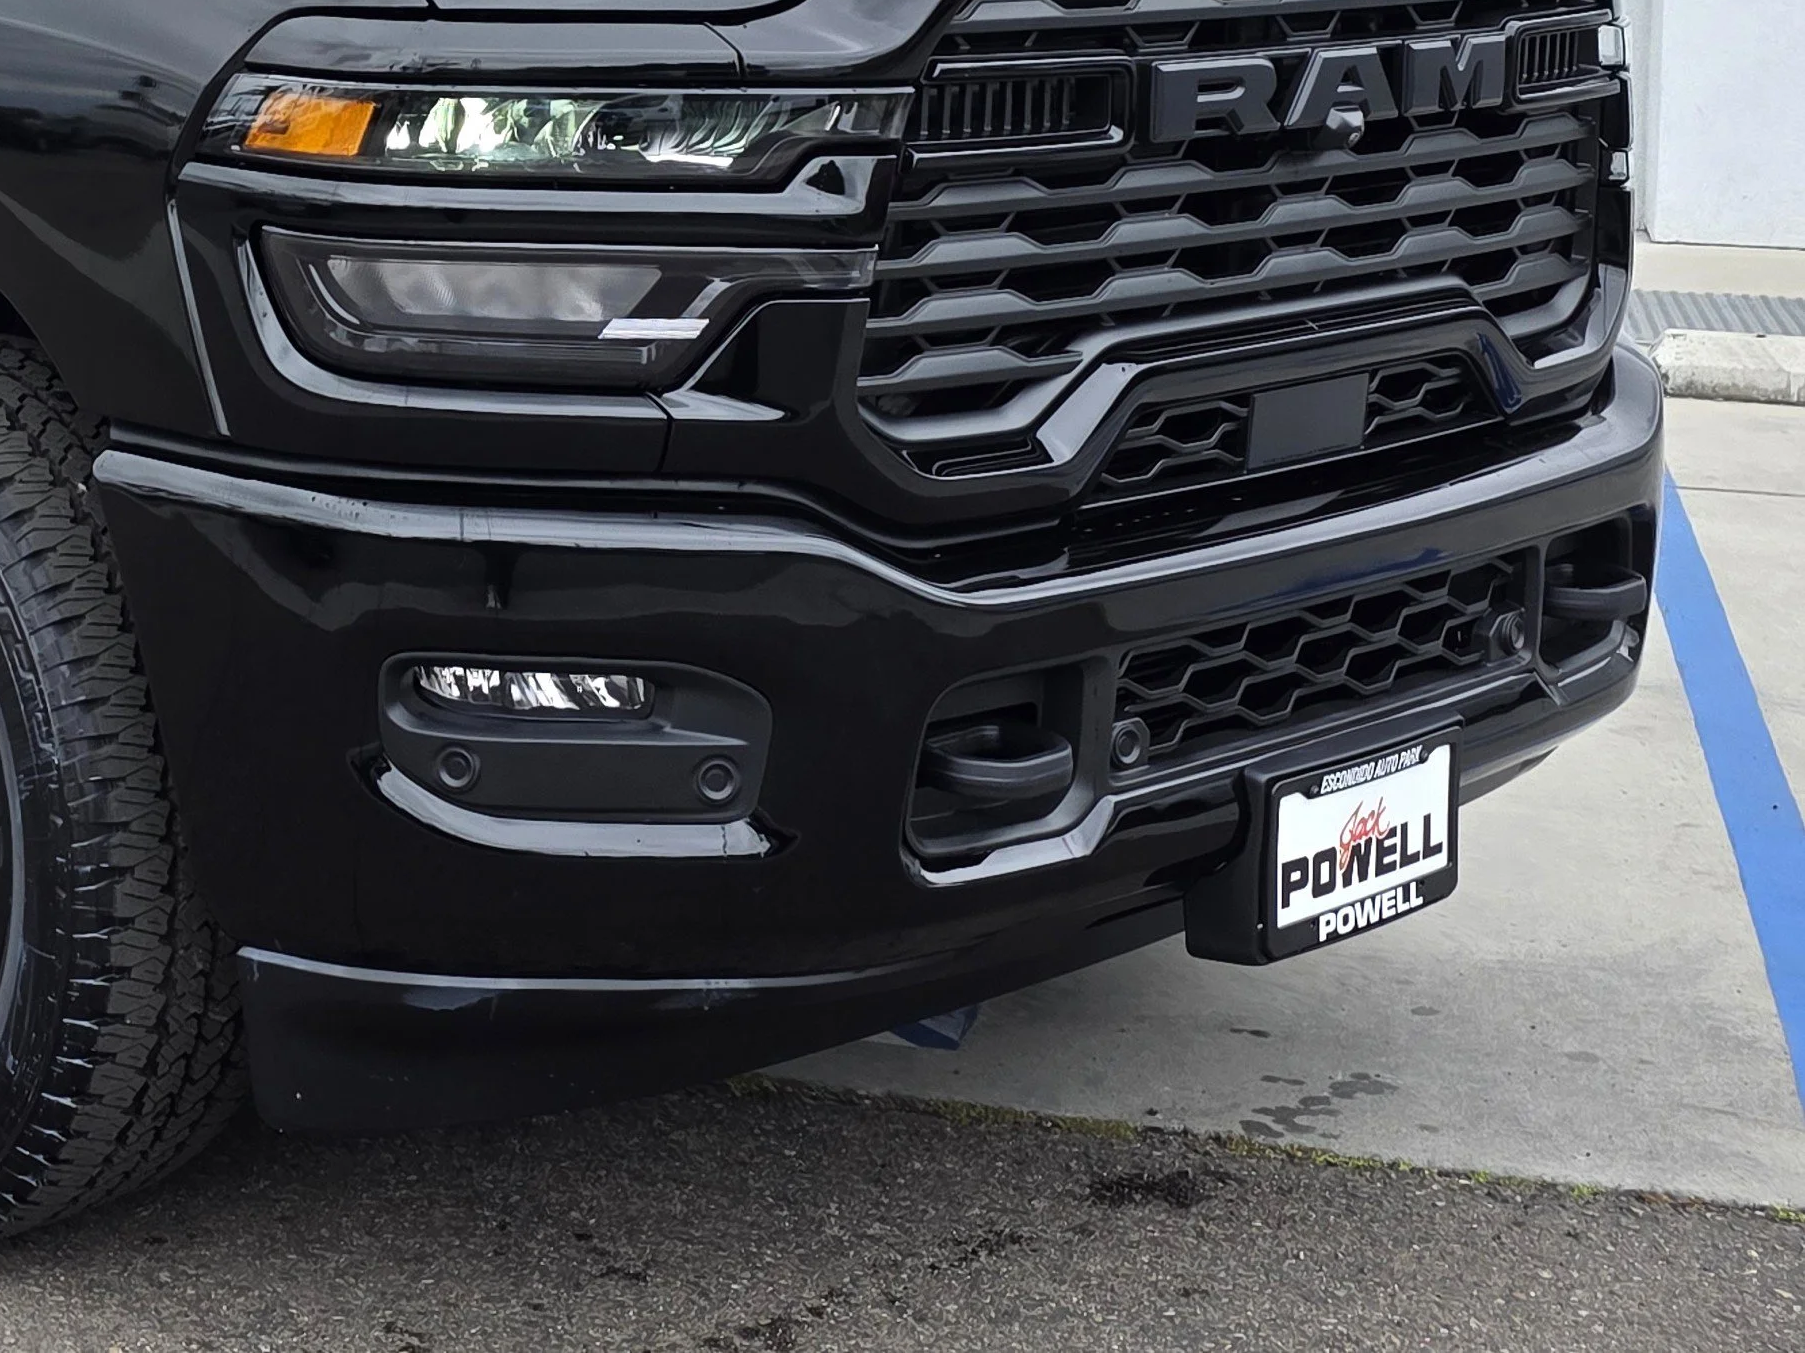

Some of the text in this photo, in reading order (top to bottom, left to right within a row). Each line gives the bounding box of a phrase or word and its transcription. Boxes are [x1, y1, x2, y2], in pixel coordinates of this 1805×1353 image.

[1150, 33, 1507, 143] RAM
[1374, 753, 1399, 778] AUTO
[1398, 745, 1423, 770] PARK
[1281, 813, 1444, 910] POWELL
[1339, 796, 1391, 871] Jack
[1319, 881, 1423, 942] POWELL
